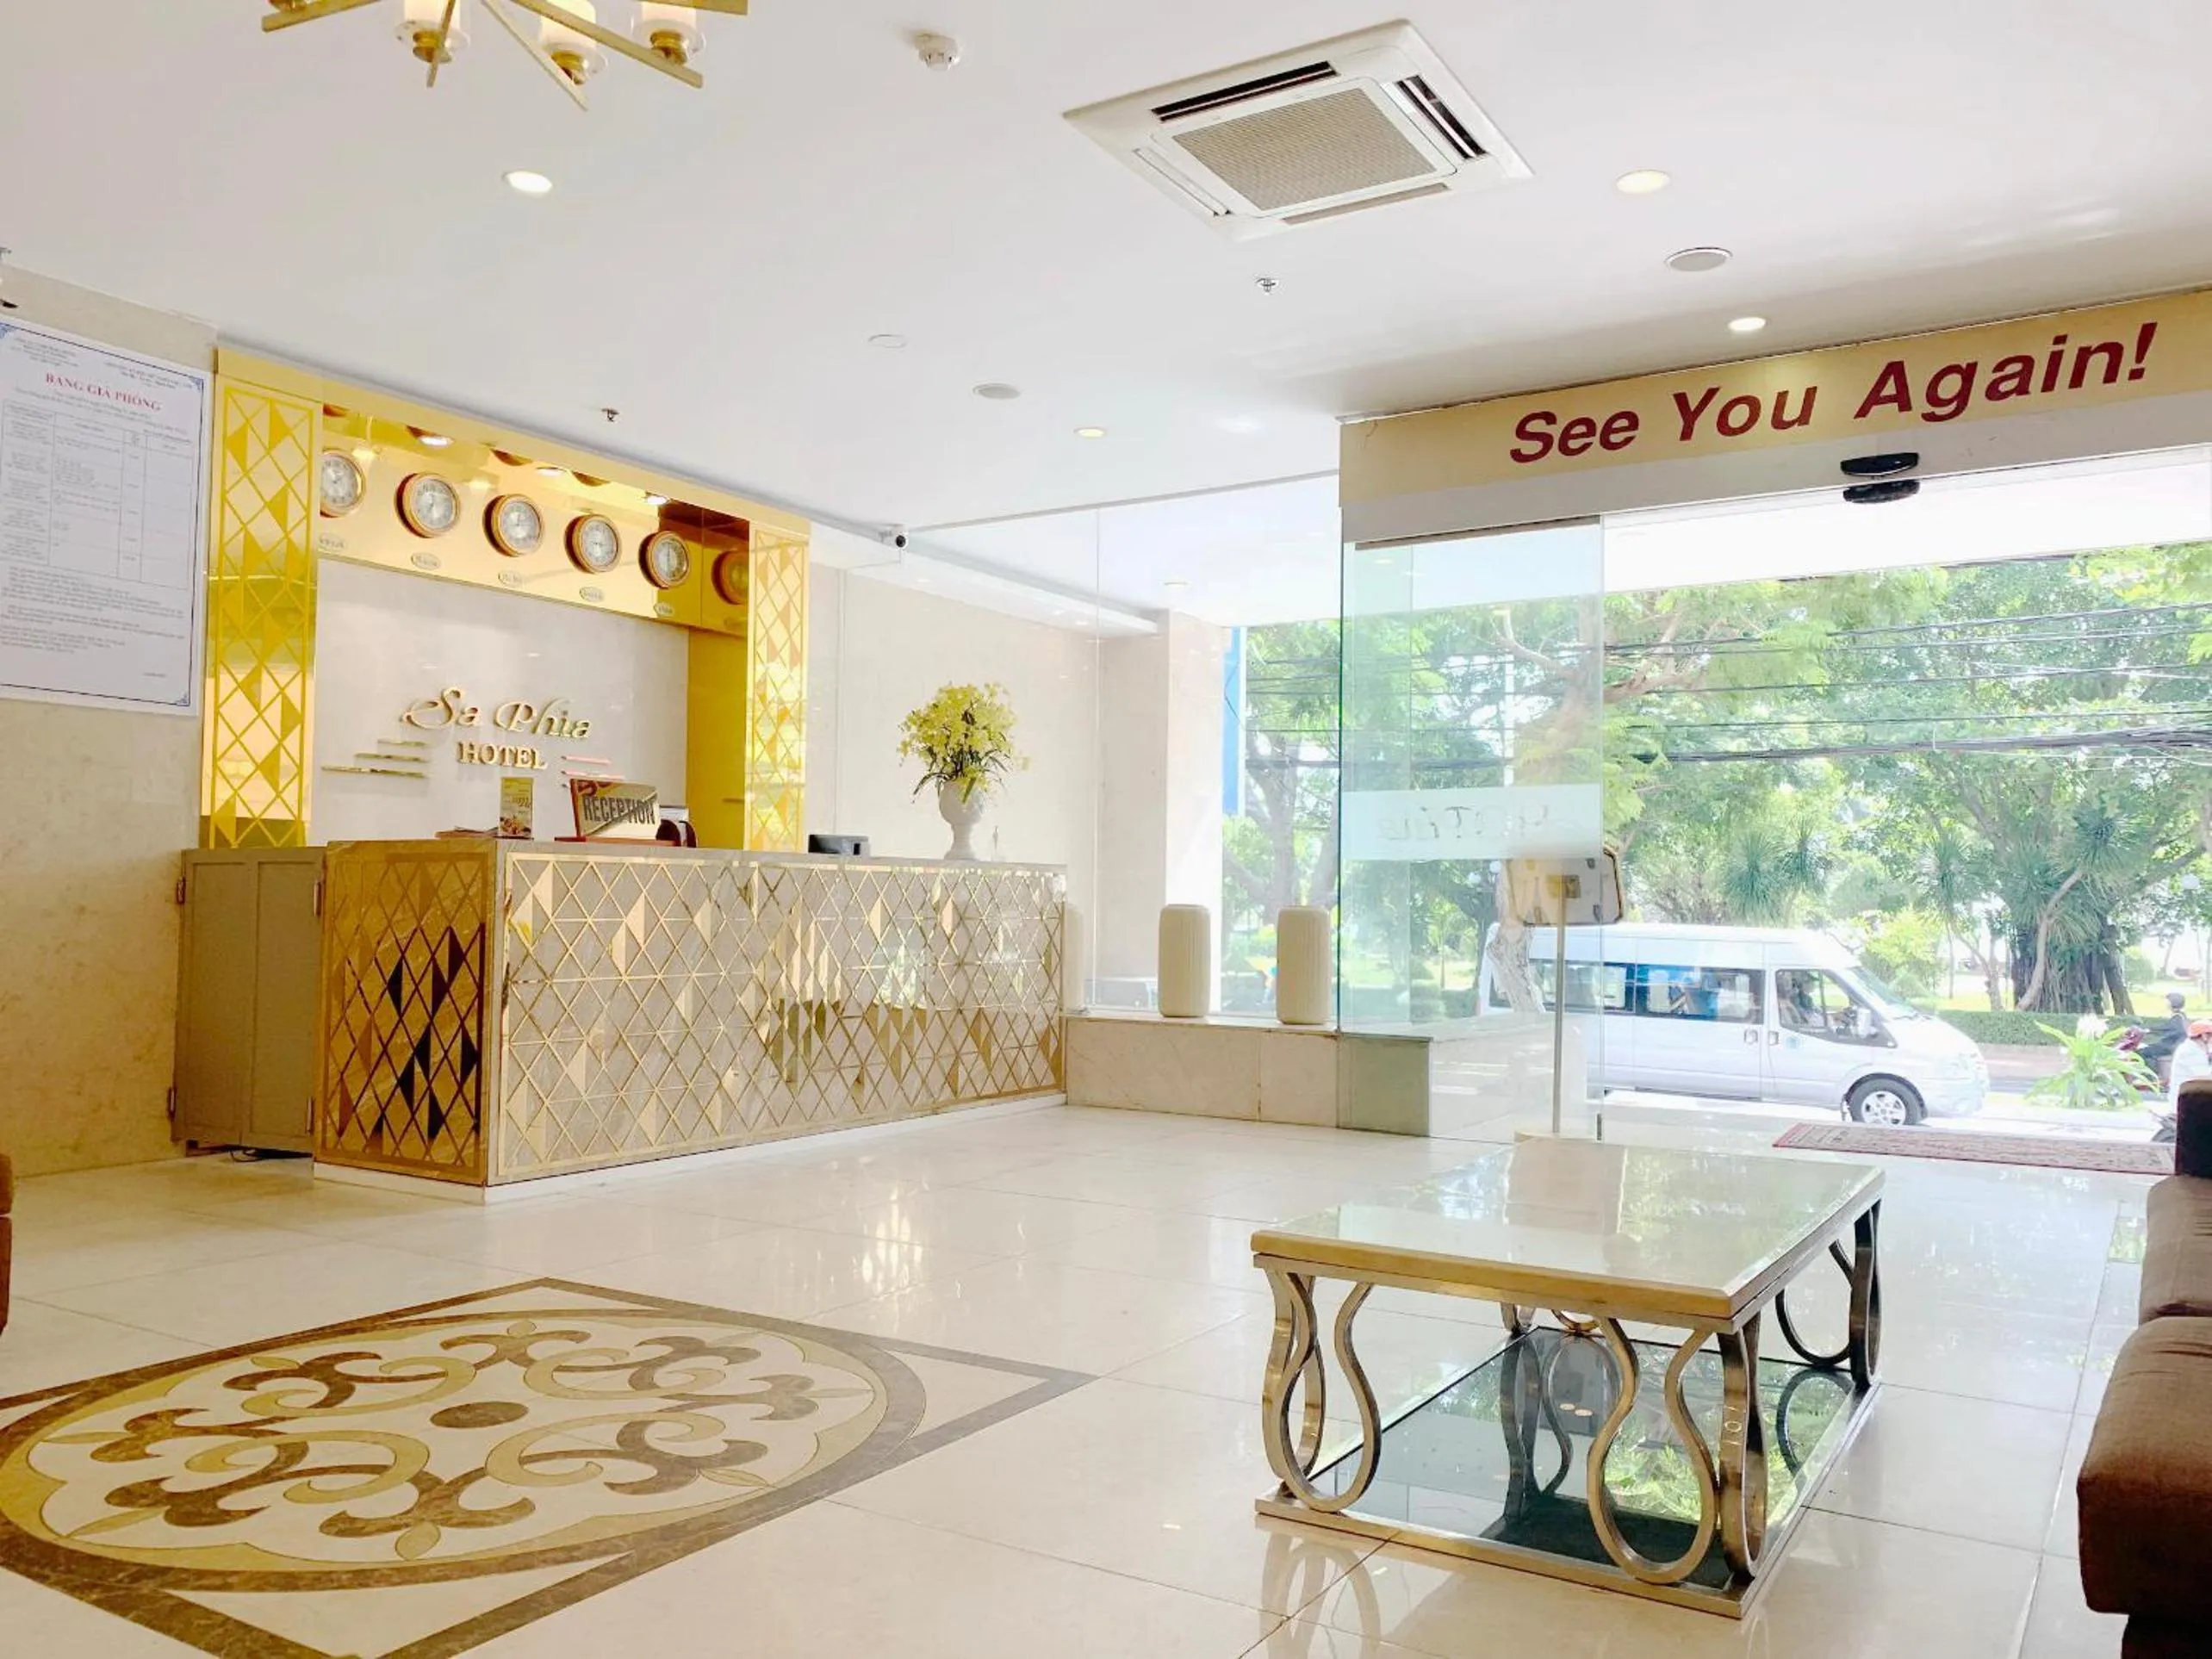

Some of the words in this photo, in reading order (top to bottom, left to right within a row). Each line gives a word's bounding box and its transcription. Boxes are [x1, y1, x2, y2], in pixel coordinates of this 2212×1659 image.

[1509, 410, 1640, 463] See
[1672, 385, 1817, 442] You
[1853, 321, 2158, 423] Again!
[400, 687, 482, 730] Sa
[493, 697, 593, 738] Phia
[457, 740, 549, 770] HOTEL
[582, 796, 656, 825] RECEPTION
